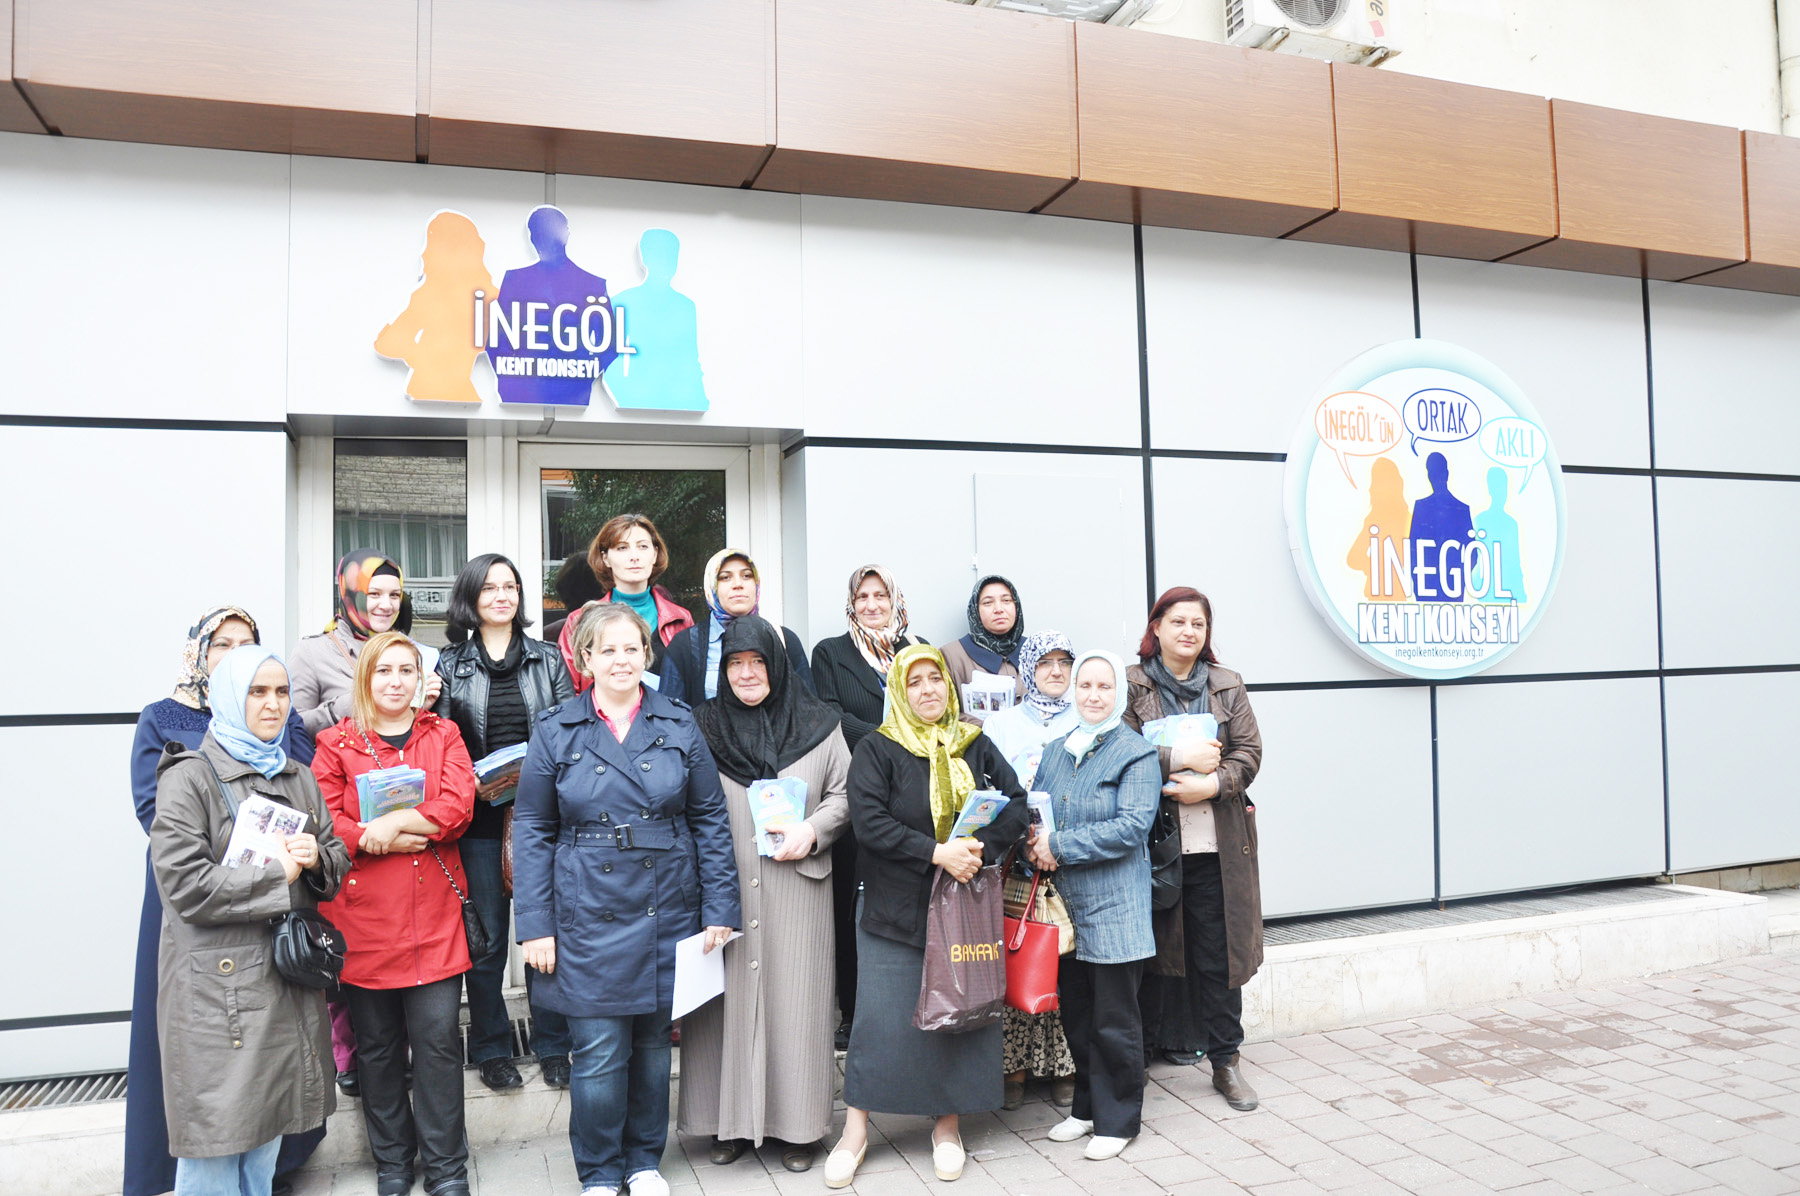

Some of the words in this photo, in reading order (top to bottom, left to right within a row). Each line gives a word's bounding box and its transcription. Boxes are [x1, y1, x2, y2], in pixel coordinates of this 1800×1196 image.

[474, 290, 637, 354] İNEGÖL
[496, 356, 534, 376] KENT
[537, 357, 599, 378] KONSEYİ
[1417, 399, 1469, 435] ORTAK
[1496, 426, 1534, 458] AKLI
[1369, 525, 1512, 599] İNEGÖL
[1358, 603, 1420, 643] KENT
[1424, 599, 1519, 643] KONSEYİ
[1395, 647, 1483, 660] inegolkentkonseyi.org.tr
[951, 942, 999, 962] BAYRAK
